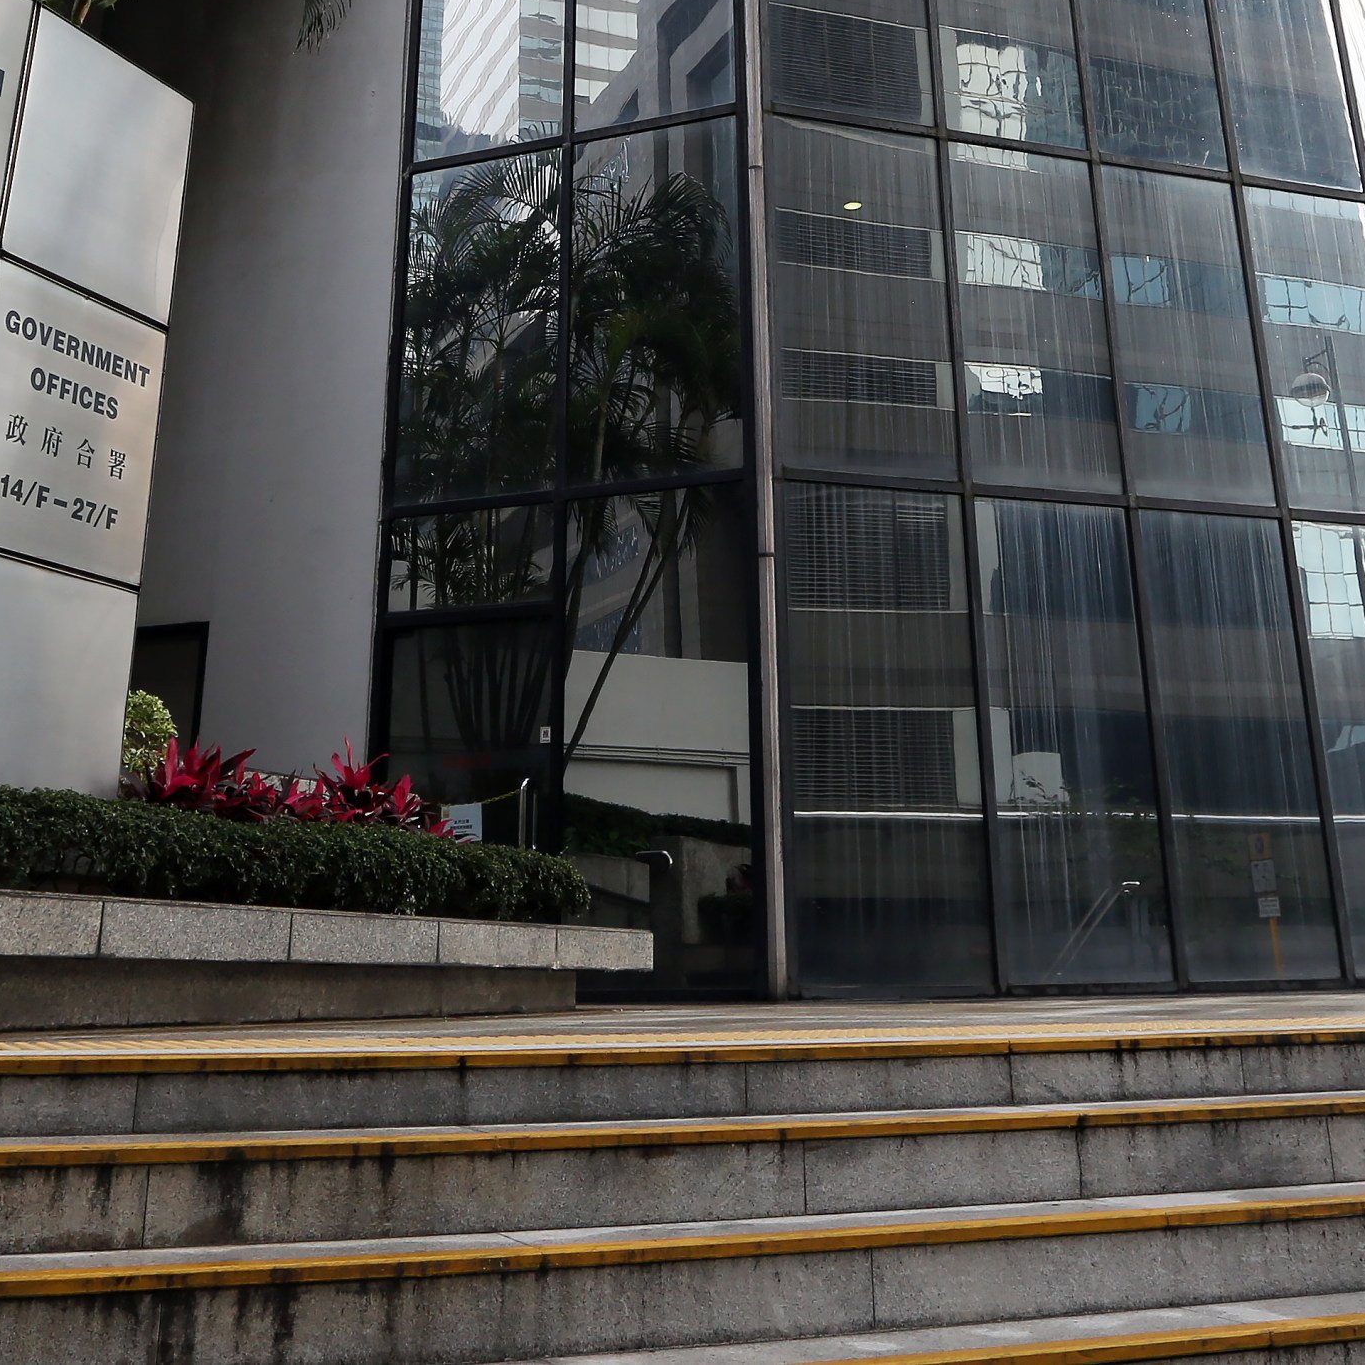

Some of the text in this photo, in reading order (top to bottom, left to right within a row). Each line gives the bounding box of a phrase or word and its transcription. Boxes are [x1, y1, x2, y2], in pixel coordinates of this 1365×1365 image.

[5, 309, 151, 388] GOVERNMENT
[30, 367, 119, 420] OFFICES
[5, 413, 127, 480] 政府合署
